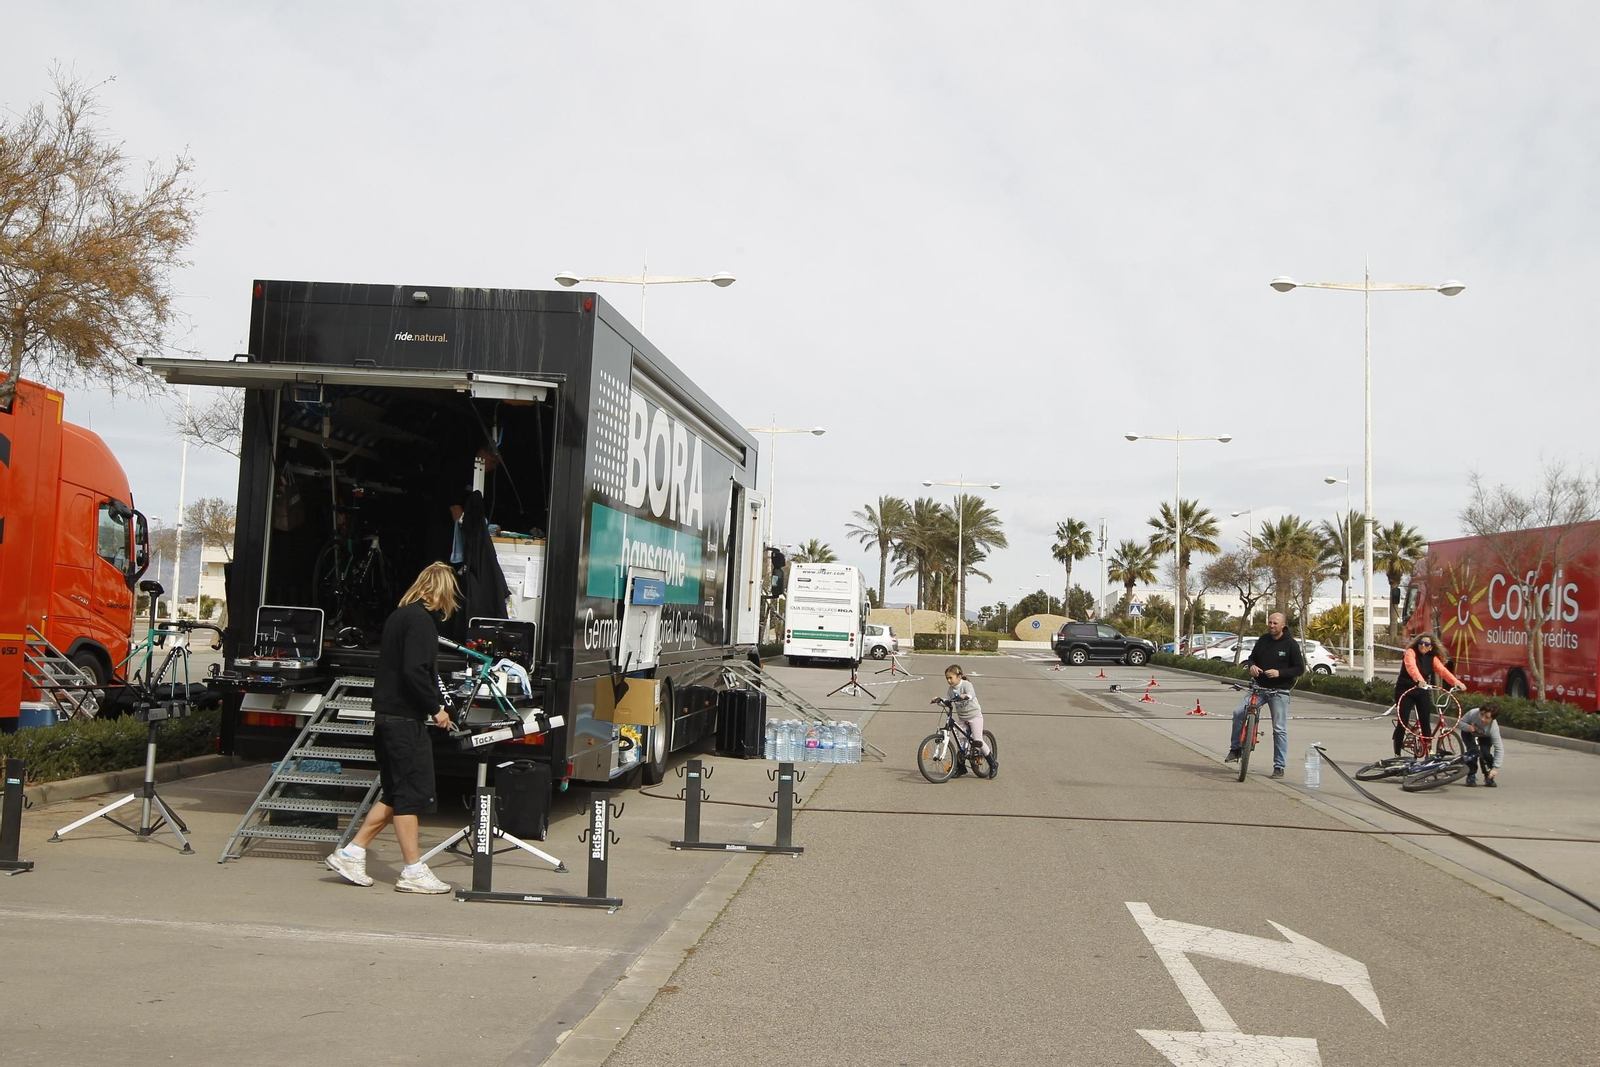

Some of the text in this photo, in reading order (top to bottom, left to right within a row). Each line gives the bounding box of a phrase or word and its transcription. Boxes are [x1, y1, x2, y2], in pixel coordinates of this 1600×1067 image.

[625, 389, 703, 531] BORA
[1488, 570, 1579, 623] Cofidis
[676, 610, 698, 651] Cycling
[1486, 625, 1528, 646] solution
[473, 734, 495, 747] Tacx
[477, 794, 489, 854] BiciSupport
[591, 800, 603, 860] BiciSupport
